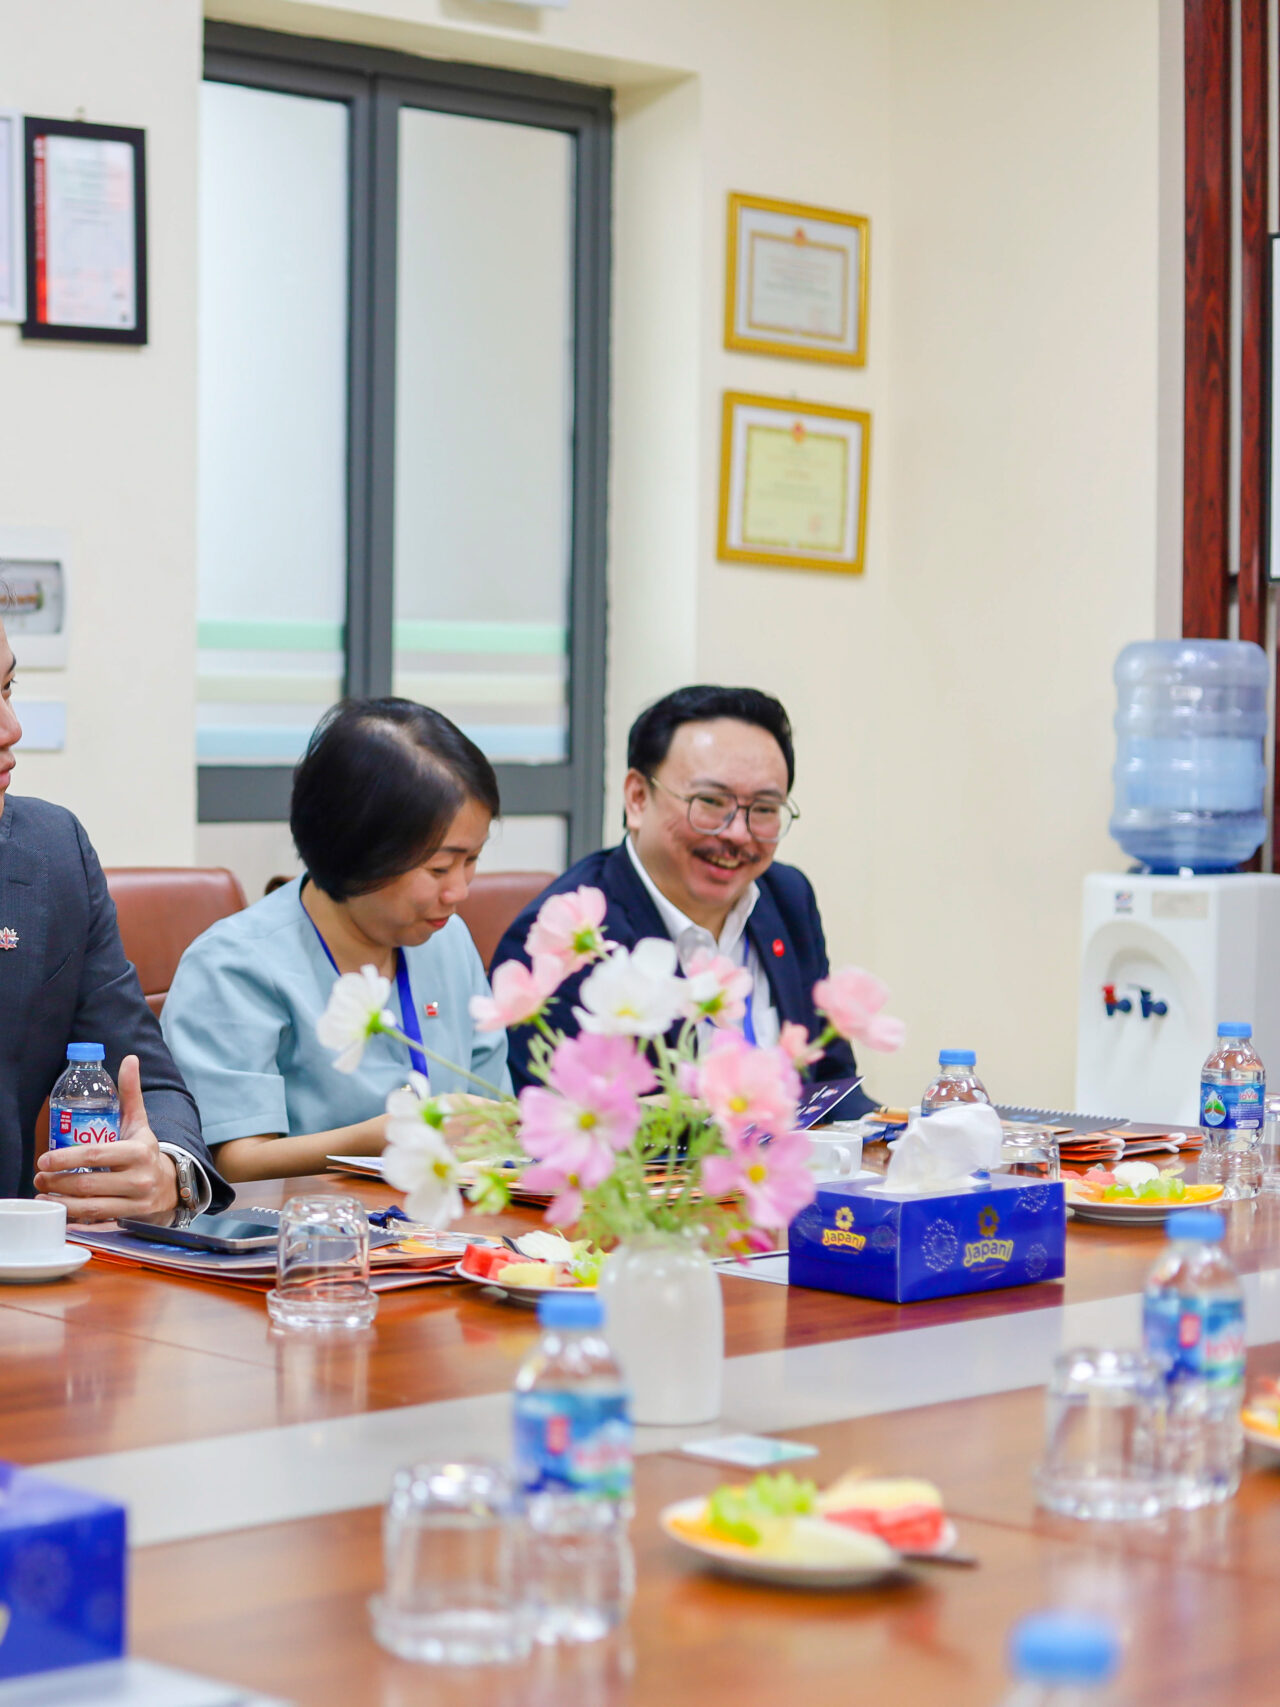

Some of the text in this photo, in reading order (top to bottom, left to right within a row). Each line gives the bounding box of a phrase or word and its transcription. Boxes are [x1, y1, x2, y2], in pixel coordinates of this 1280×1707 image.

[73, 1126, 117, 1144] laVie
[822, 1229, 866, 1251] Japani
[964, 1239, 1014, 1267] Japani
